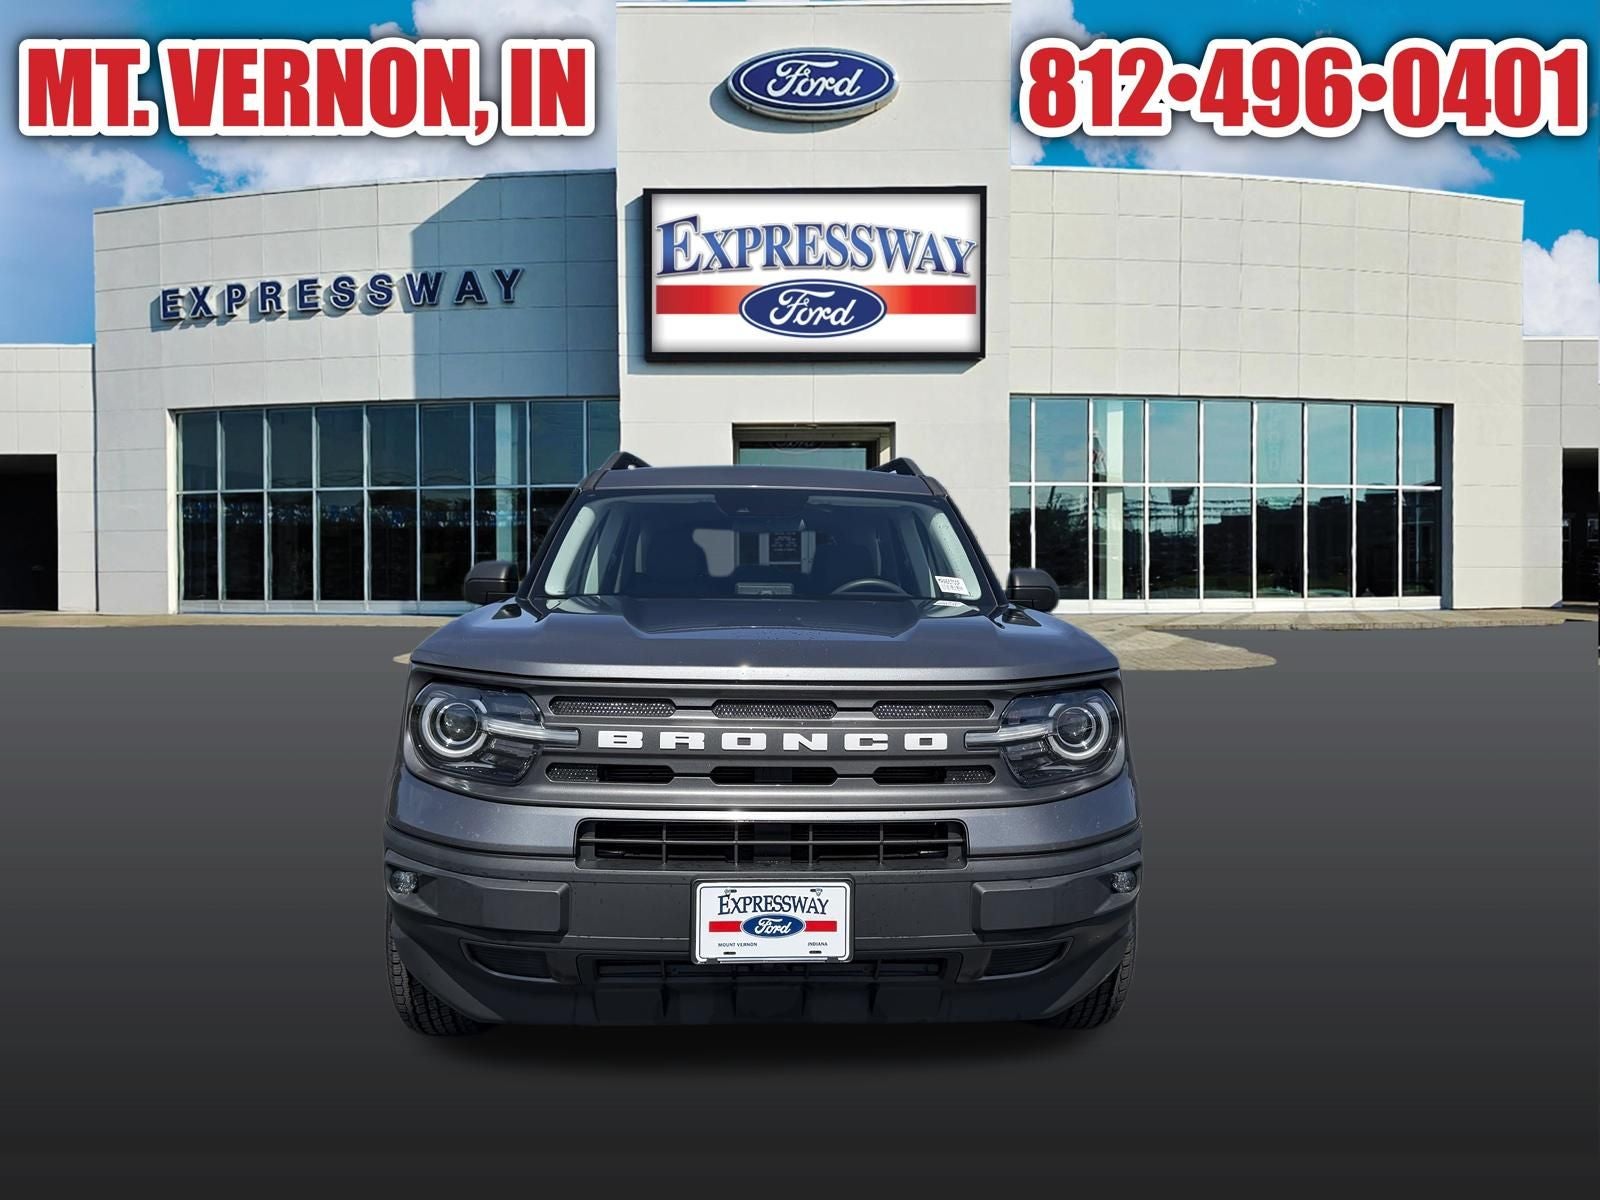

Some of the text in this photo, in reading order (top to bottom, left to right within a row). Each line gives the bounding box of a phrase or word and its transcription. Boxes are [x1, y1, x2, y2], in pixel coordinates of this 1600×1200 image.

[766, 59, 863, 97] Ford
[656, 215, 977, 278] EXPRESSWAY
[160, 268, 525, 321] EXPRESSWAY
[769, 287, 857, 326] Ford
[597, 730, 948, 752] BRONCO
[717, 894, 829, 916] EXPRESSWAY
[754, 917, 792, 935] Ford
